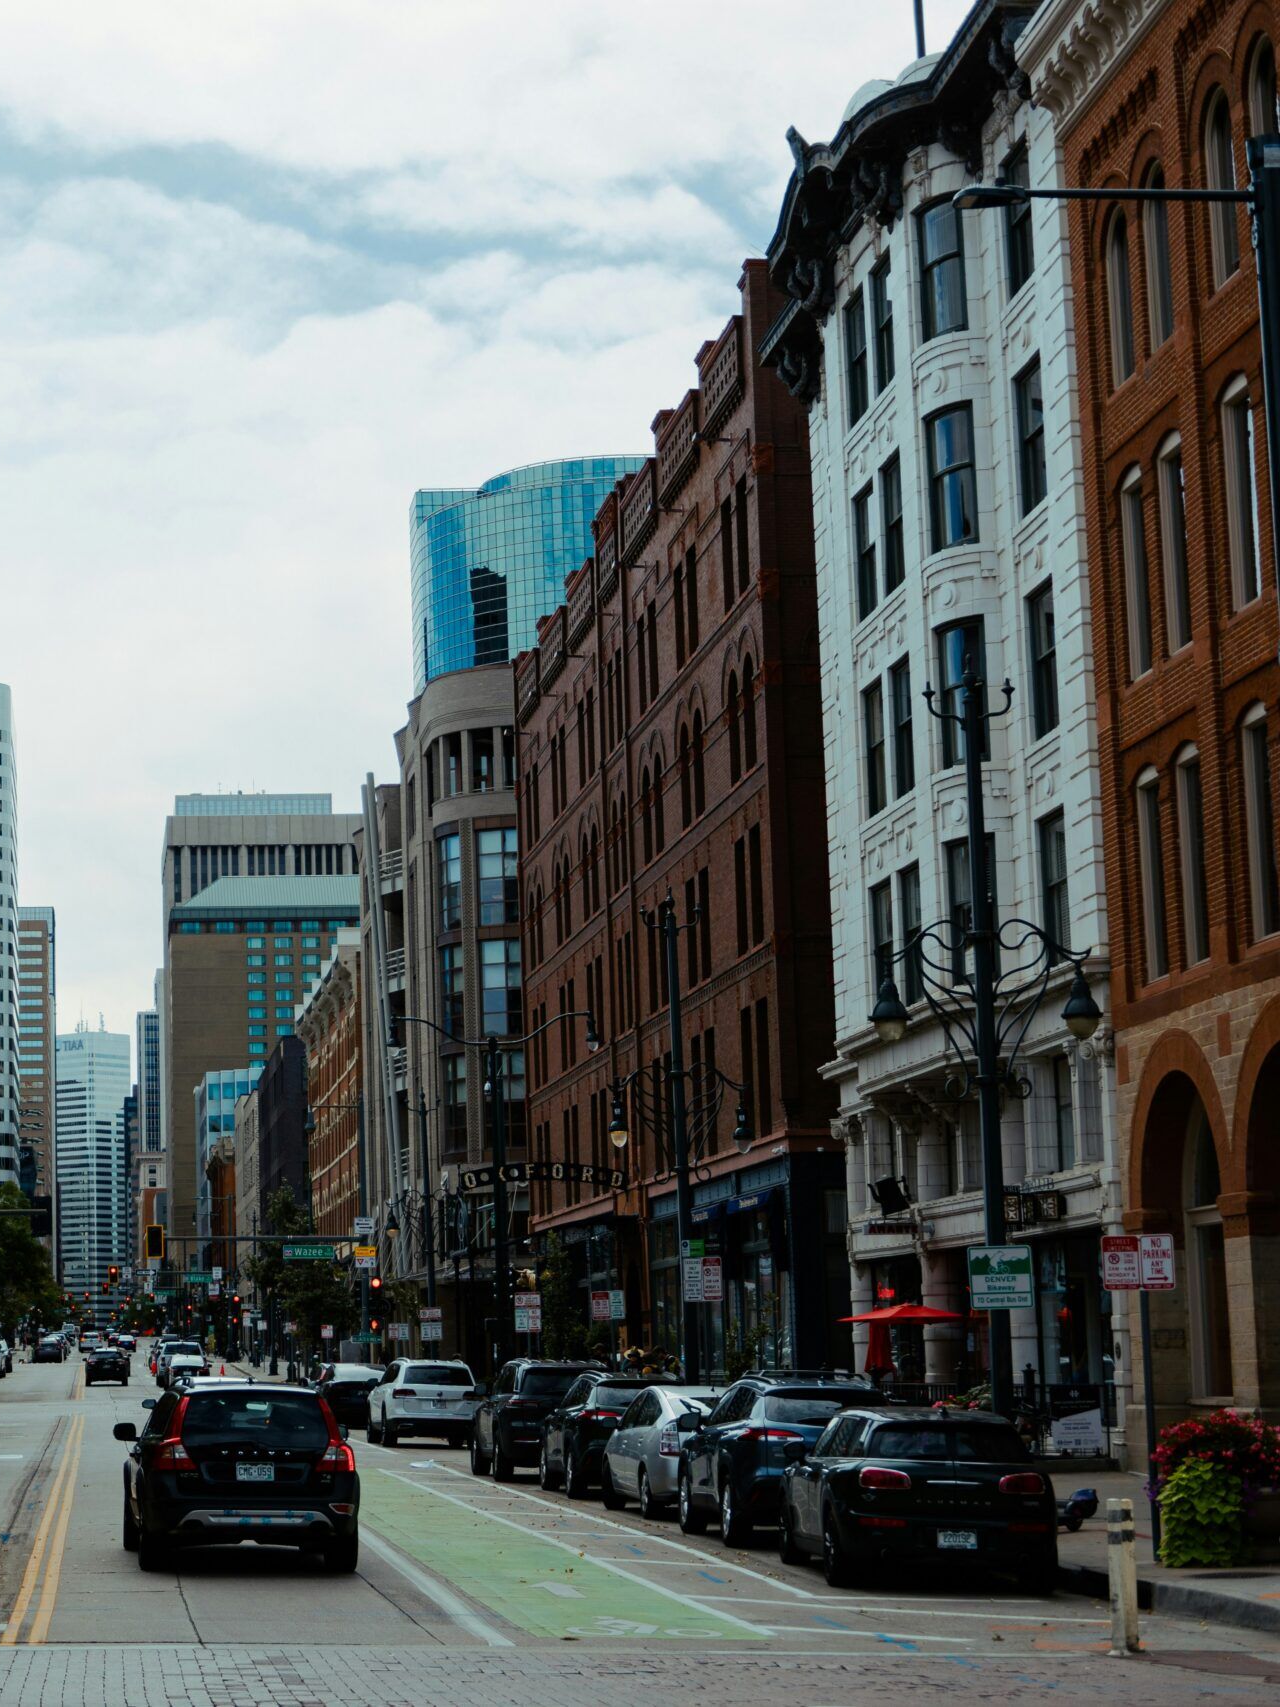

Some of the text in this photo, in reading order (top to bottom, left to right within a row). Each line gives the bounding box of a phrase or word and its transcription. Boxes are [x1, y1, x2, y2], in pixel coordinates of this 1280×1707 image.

[62, 1039, 84, 1051] TIAA
[1150, 1238, 1162, 1248] NO
[294, 1247, 323, 1256] Wazee
[1143, 1249, 1171, 1259] PARKING
[985, 1275, 1017, 1283] DENVER
[987, 1284, 1016, 1292] Bikeway
